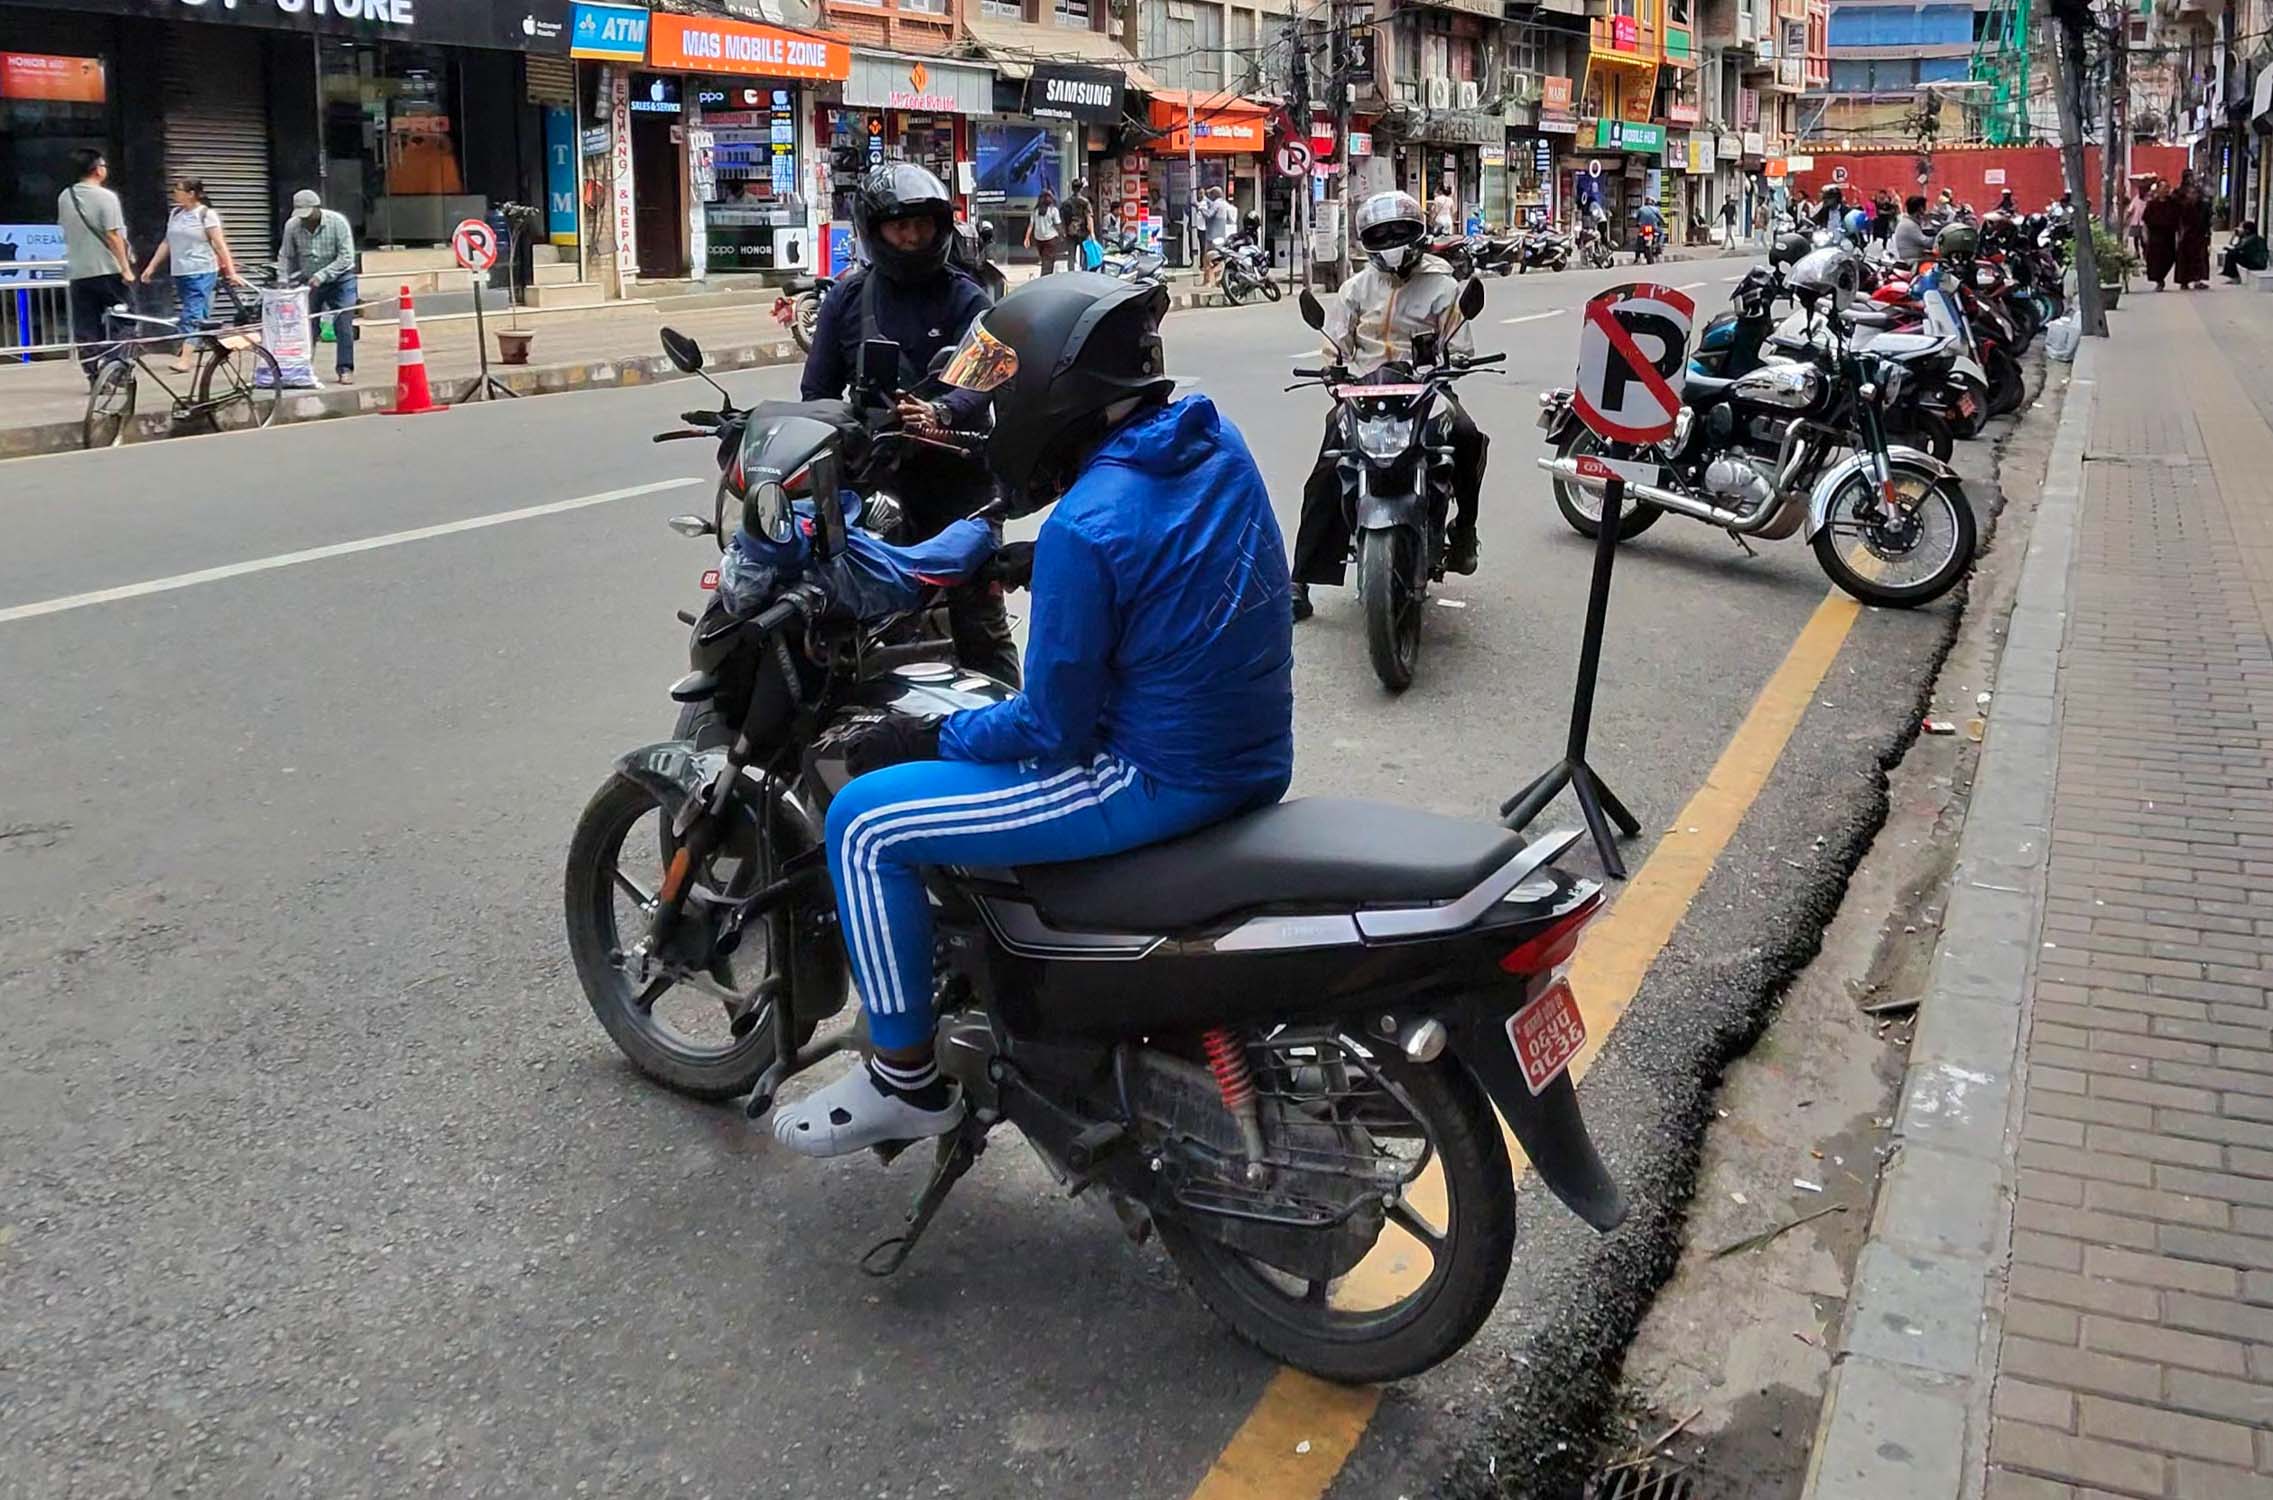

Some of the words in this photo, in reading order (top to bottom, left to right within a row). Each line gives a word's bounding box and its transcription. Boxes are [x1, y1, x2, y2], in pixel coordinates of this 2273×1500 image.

[601, 17, 645, 42] ATM
[682, 30, 720, 58] MAS
[725, 34, 784, 65] MOBILE
[786, 41, 827, 67] ZONE
[1046, 79, 1112, 107] SAMSUNG
[631, 101, 650, 111] SALES
[656, 103, 681, 112] SERVICE
[1622, 127, 1643, 143] MOBILE
[1643, 131, 1656, 144] HUB
[707, 246, 735, 257] oppo
[740, 245, 772, 254] HONOR
[1601, 309, 1686, 412] P
[747, 466, 782, 475] HONDA
